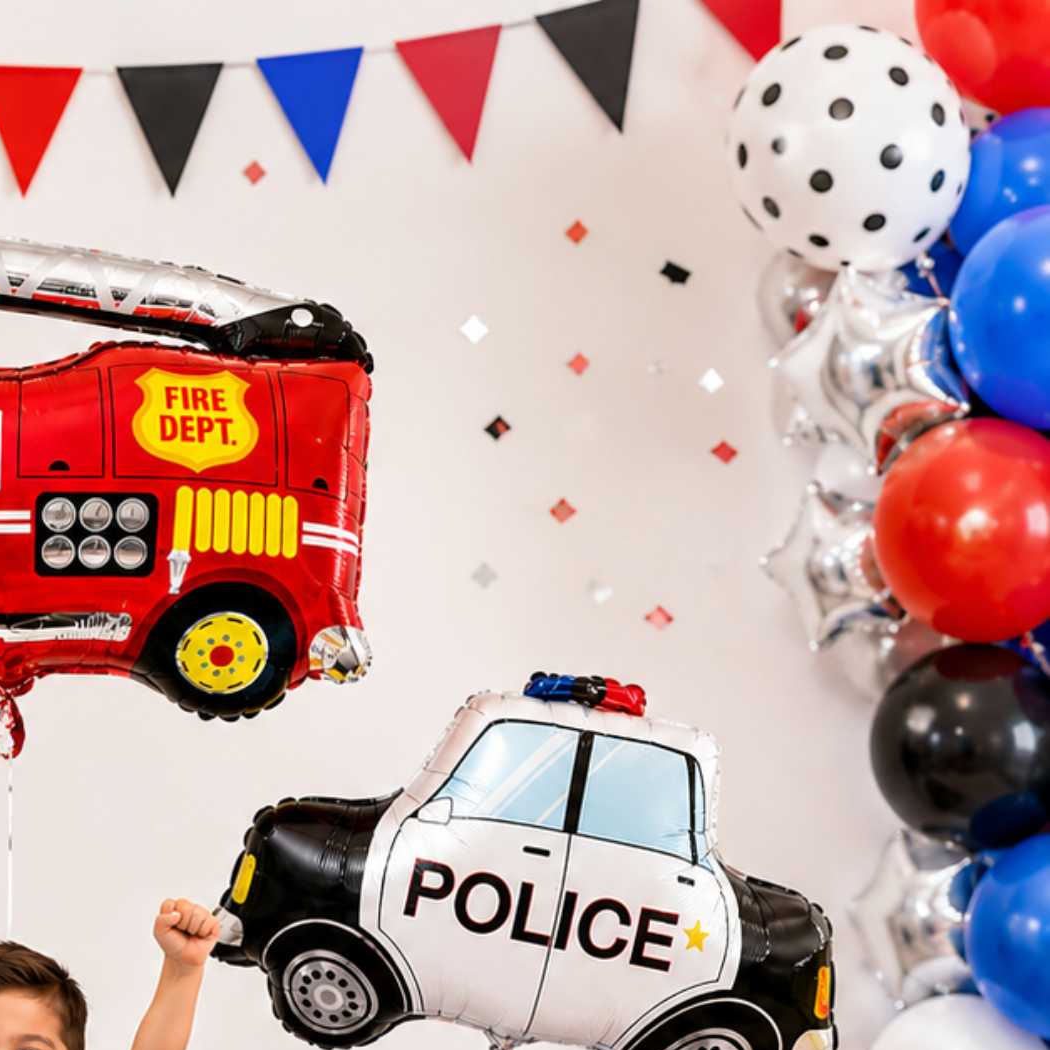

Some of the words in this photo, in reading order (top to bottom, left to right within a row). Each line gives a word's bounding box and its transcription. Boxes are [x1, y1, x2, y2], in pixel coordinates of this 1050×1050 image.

[165, 386, 227, 412] FIRE
[159, 414, 237, 446] DEPT.
[403, 857, 680, 973] POLICE
